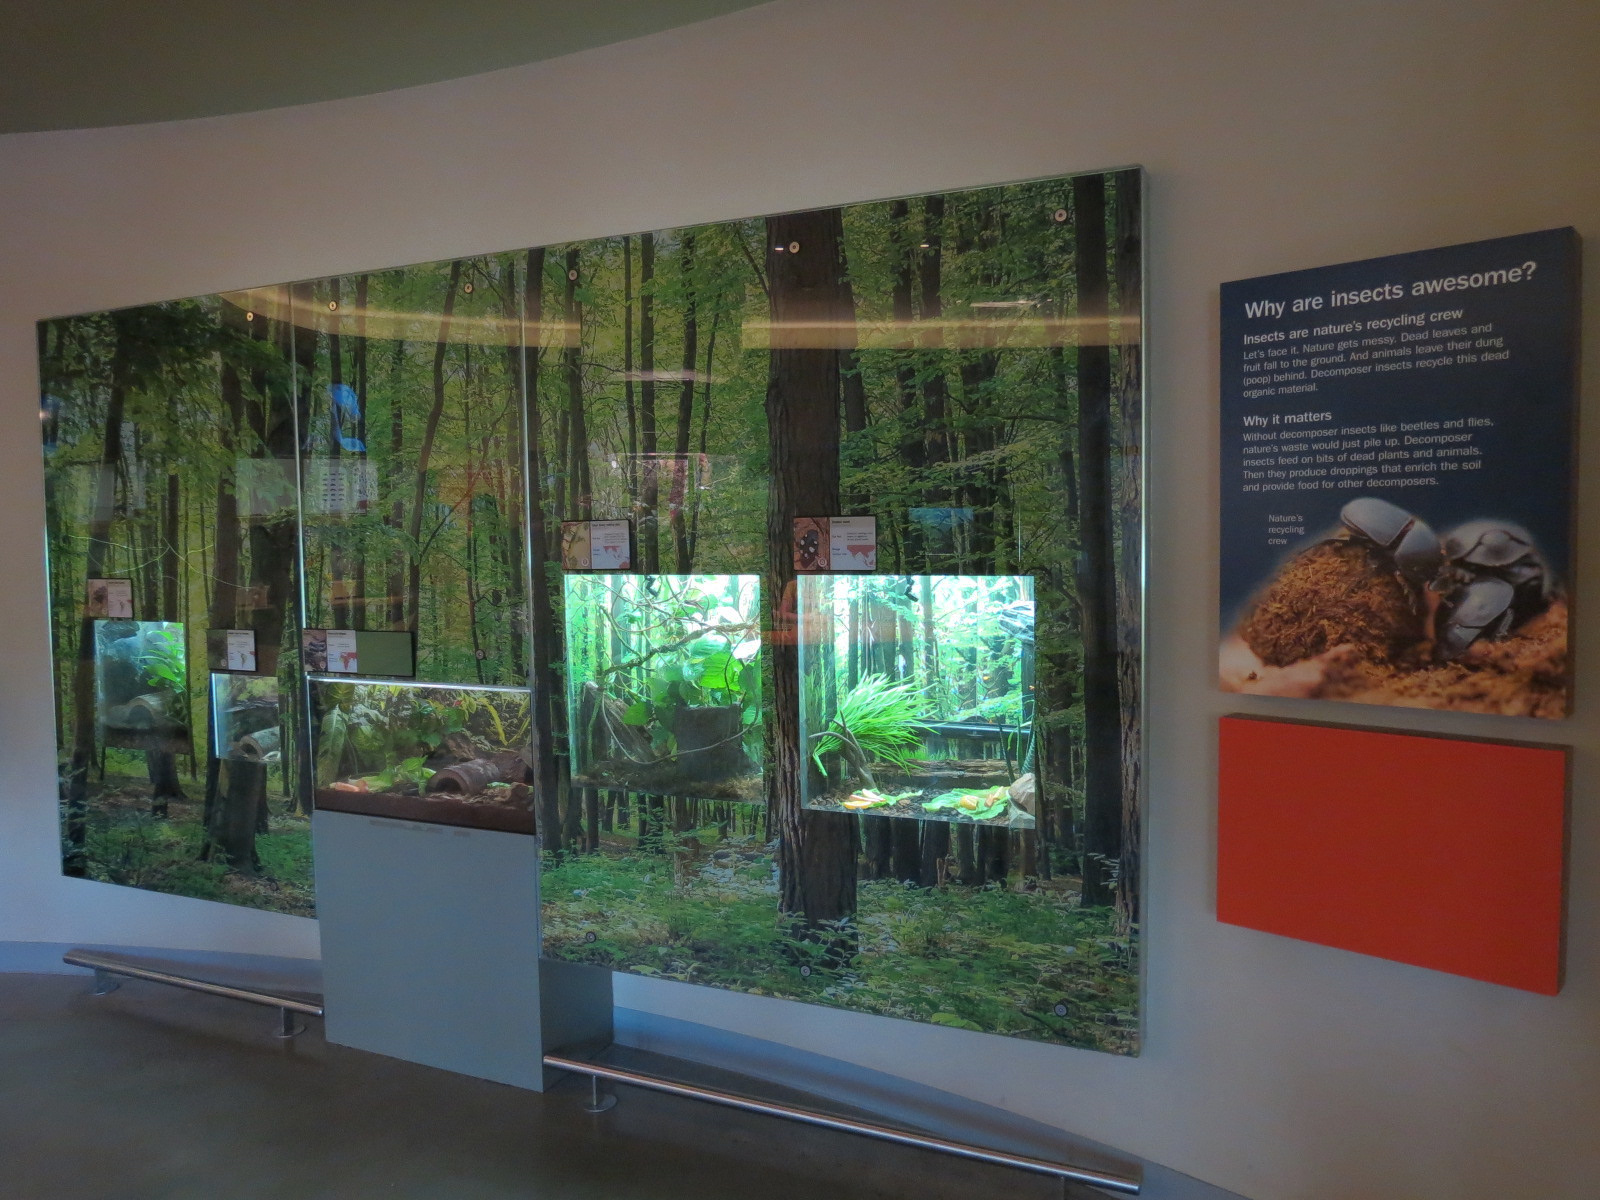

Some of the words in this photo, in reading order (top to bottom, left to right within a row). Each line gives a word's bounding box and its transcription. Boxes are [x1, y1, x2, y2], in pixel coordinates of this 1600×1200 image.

[1245, 300, 1285, 319] Why
[1292, 296, 1323, 312] are
[1331, 282, 1404, 307] insects
[1412, 261, 1537, 296] awesome?
[1244, 330, 1285, 345] Insects
[1289, 328, 1308, 340] are
[1314, 320, 1362, 336] nature's
[1367, 312, 1426, 330] recycling
[1430, 309, 1464, 322] crew
[1244, 350, 1264, 360] Let's
[1268, 348, 1288, 357] face
[1290, 346, 1299, 354] it.
[1303, 343, 1334, 353] Nature
[1338, 340, 1358, 351] gets
[1362, 336, 1396, 346] messy.
[1401, 330, 1428, 342] Dead
[1432, 327, 1467, 338] leaves
[1471, 323, 1492, 333] and
[1244, 362, 1260, 372] fruit
[1264, 362, 1277, 370] fall
[1280, 360, 1289, 368] to
[1293, 358, 1307, 367] the
[1311, 354, 1346, 367] ground.
[1350, 352, 1368, 361] And
[1372, 346, 1412, 359] animals
[1416, 343, 1443, 355] leave
[1448, 340, 1472, 351] their
[1476, 337, 1504, 348] dung
[1244, 374, 1270, 387] (poop)
[1274, 371, 1307, 382] behind.
[1311, 365, 1372, 379] Decomposer
[1376, 360, 1412, 372] insects
[1416, 357, 1452, 369] recycle
[1457, 354, 1477, 364] this
[1481, 350, 1509, 362] dead
[1244, 387, 1275, 399] organic
[1278, 383, 1318, 394] material.
[1243, 416, 1268, 427] Why
[1273, 414, 1280, 424] it
[1285, 412, 1332, 423] matters
[1243, 432, 1277, 441] Without
[1280, 428, 1338, 440] decomposer
[1341, 425, 1377, 434] insects
[1380, 424, 1396, 432] like
[1400, 421, 1439, 431] beetles
[1444, 419, 1464, 428] and
[1243, 445, 1278, 454] nature's
[1282, 444, 1308, 452] waste
[1312, 441, 1339, 450] would
[1341, 440, 1360, 450] just
[1364, 438, 1381, 448] pile
[1385, 438, 1400, 448] up.
[1405, 434, 1473, 445] Decomposer
[1243, 458, 1274, 466] insects
[1278, 456, 1298, 465] feed
[1301, 456, 1313, 464] on
[1337, 453, 1347, 462] of
[1350, 452, 1375, 461] dead
[1379, 451, 1409, 461] plants
[1413, 448, 1433, 458] and
[1437, 446, 1483, 456] animals.
[1243, 470, 1264, 479] Then
[1268, 469, 1287, 479] they
[1290, 468, 1327, 478] produce
[1330, 466, 1378, 476] droppings
[1381, 464, 1402, 473] that
[1405, 462, 1437, 472] enrich
[1441, 461, 1458, 470] the
[1462, 460, 1481, 470] soil
[1243, 483, 1260, 492] and
[1262, 481, 1295, 492] provide
[1298, 481, 1319, 490] food
[1322, 480, 1335, 489] for
[1338, 480, 1363, 488] other
[1367, 477, 1439, 487] decomposers.
[1268, 514, 1303, 522] Nature's
[1269, 526, 1304, 535] recycling
